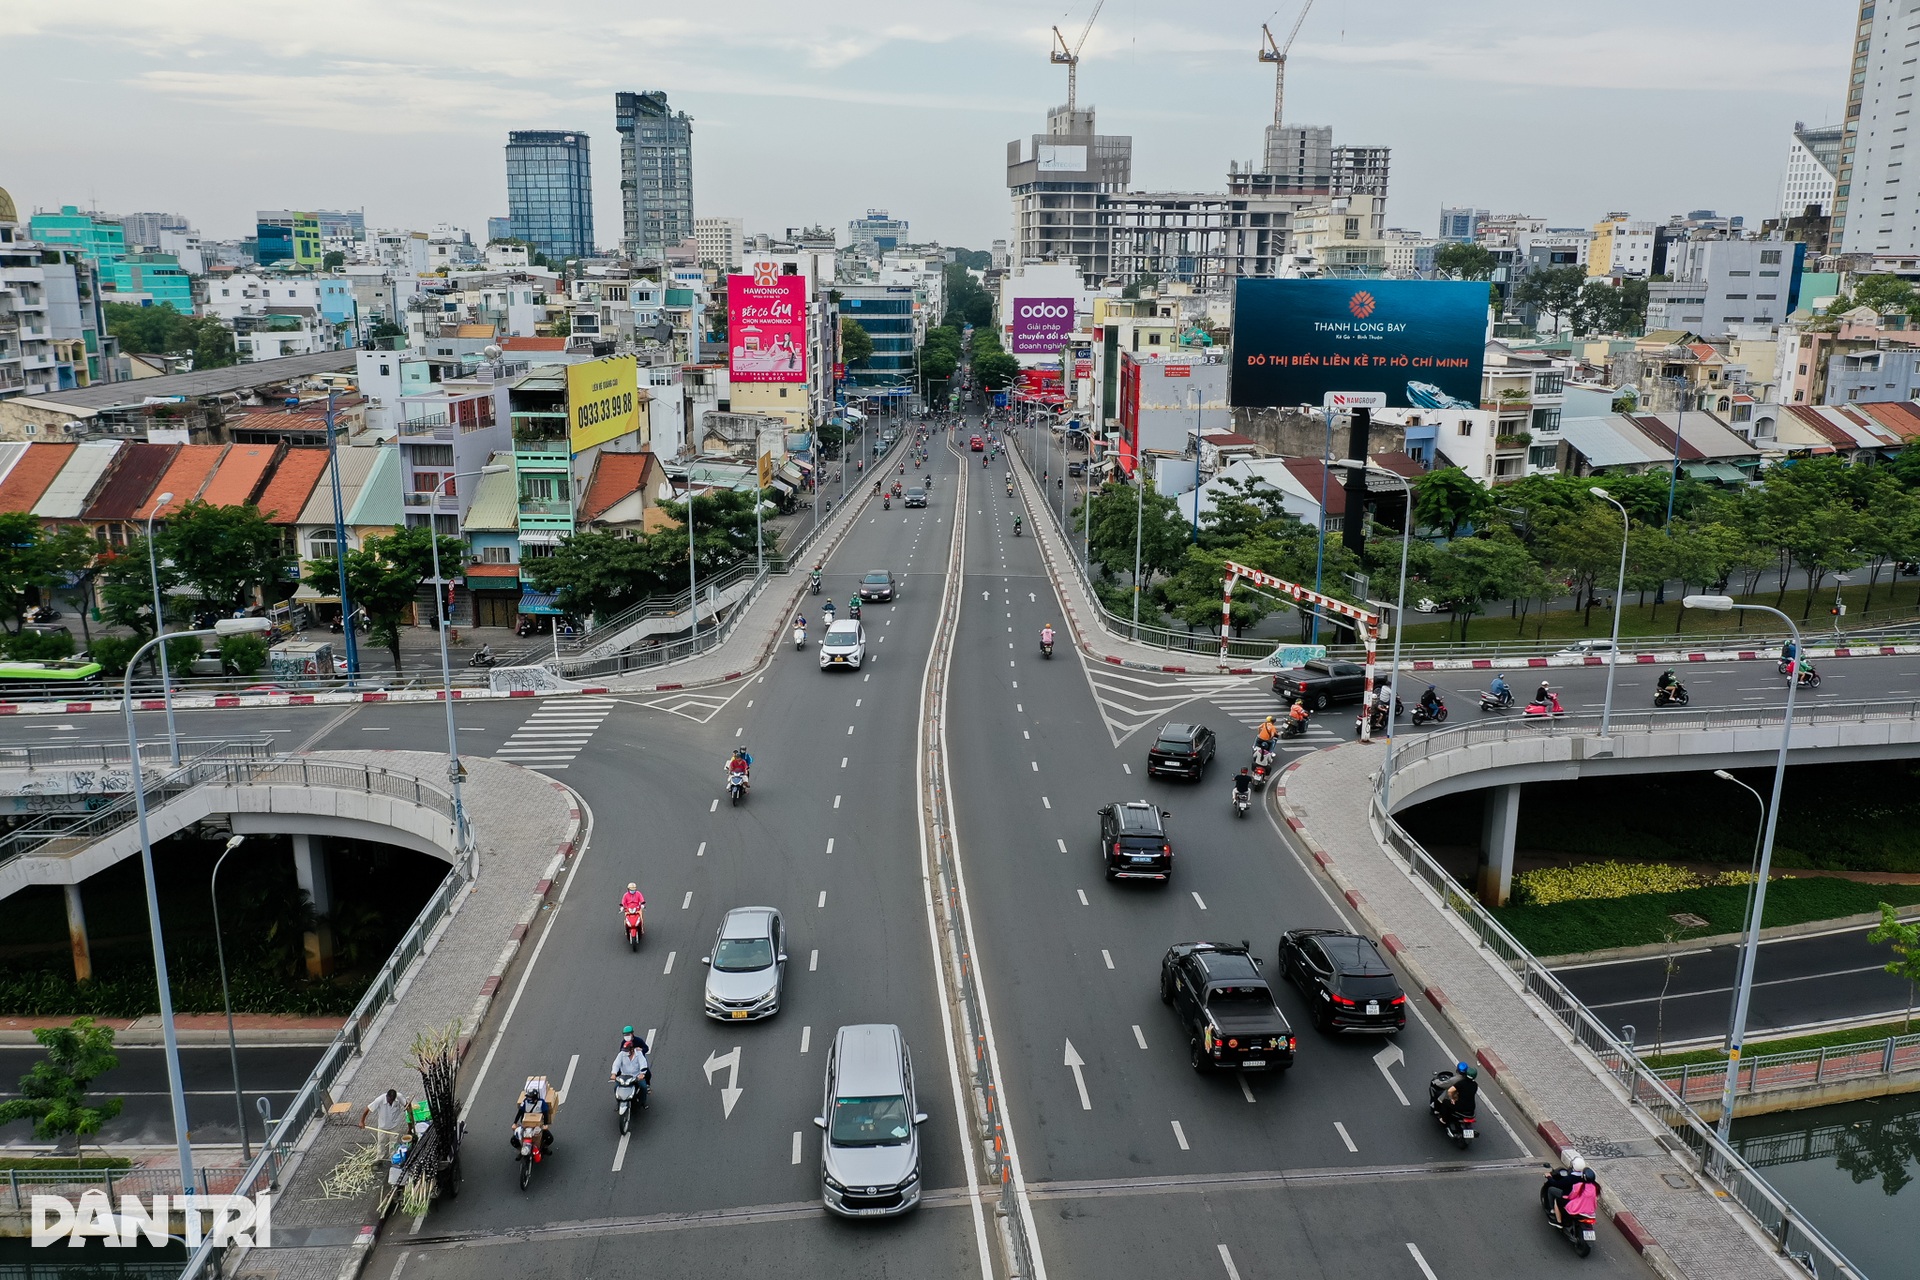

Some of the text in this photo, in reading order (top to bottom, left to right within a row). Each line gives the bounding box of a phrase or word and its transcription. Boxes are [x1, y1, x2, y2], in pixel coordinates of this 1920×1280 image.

[743, 287, 790, 295] HAWONKOO
[1020, 301, 1068, 318] odoo
[1027, 322, 1061, 332] Giải pháp
[1314, 322, 1407, 332] THANH LONG BAY
[1018, 331, 1045, 342] chuyển
[1046, 331, 1059, 340] đổi
[1018, 342, 1042, 350] doanh
[1148, 355, 1216, 364] BILLIARDS
[1247, 352, 1469, 368] ĐÔ THỊ BIỂN LIỀN KỀ TP. HỒ CHÍ MINH
[578, 392, 633, 429] 0933.33.99.88
